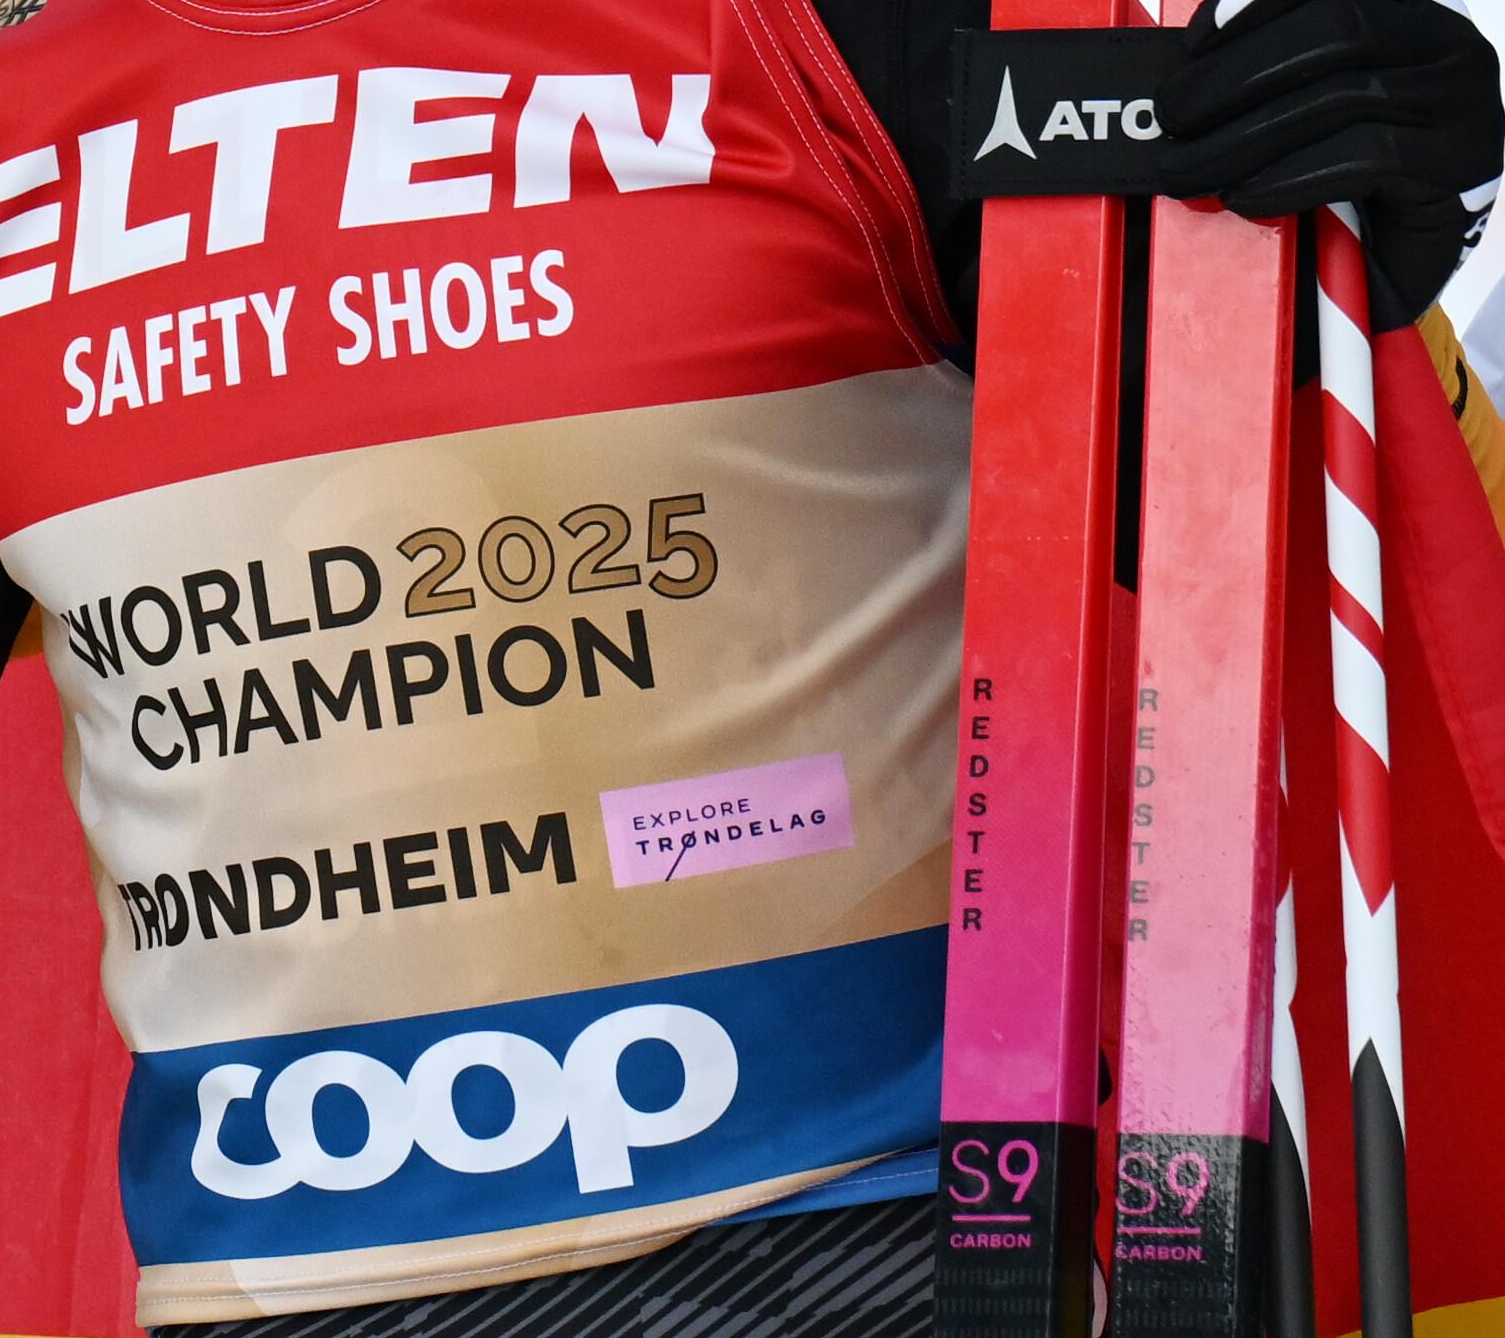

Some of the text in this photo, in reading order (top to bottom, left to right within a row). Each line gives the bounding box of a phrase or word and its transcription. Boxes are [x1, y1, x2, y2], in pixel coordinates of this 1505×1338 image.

[61, 248, 576, 426] SAFETY SHOES
[61, 492, 719, 680] WORLD 2025
[129, 607, 657, 773] CHAMPION
[631, 797, 753, 833] EXPLORE
[634, 807, 829, 868] TRØNDELAG
[961, 675, 994, 933] REDSTER
[1126, 684, 1159, 944] REDSTER
[117, 811, 579, 953] TRONDHEIM
[190, 1002, 740, 1201] coop
[947, 1136, 1040, 1207] S9
[949, 1231, 1033, 1250] CARBON
[1113, 1147, 1213, 1219] S9
[1114, 1241, 1202, 1262] CARBON
